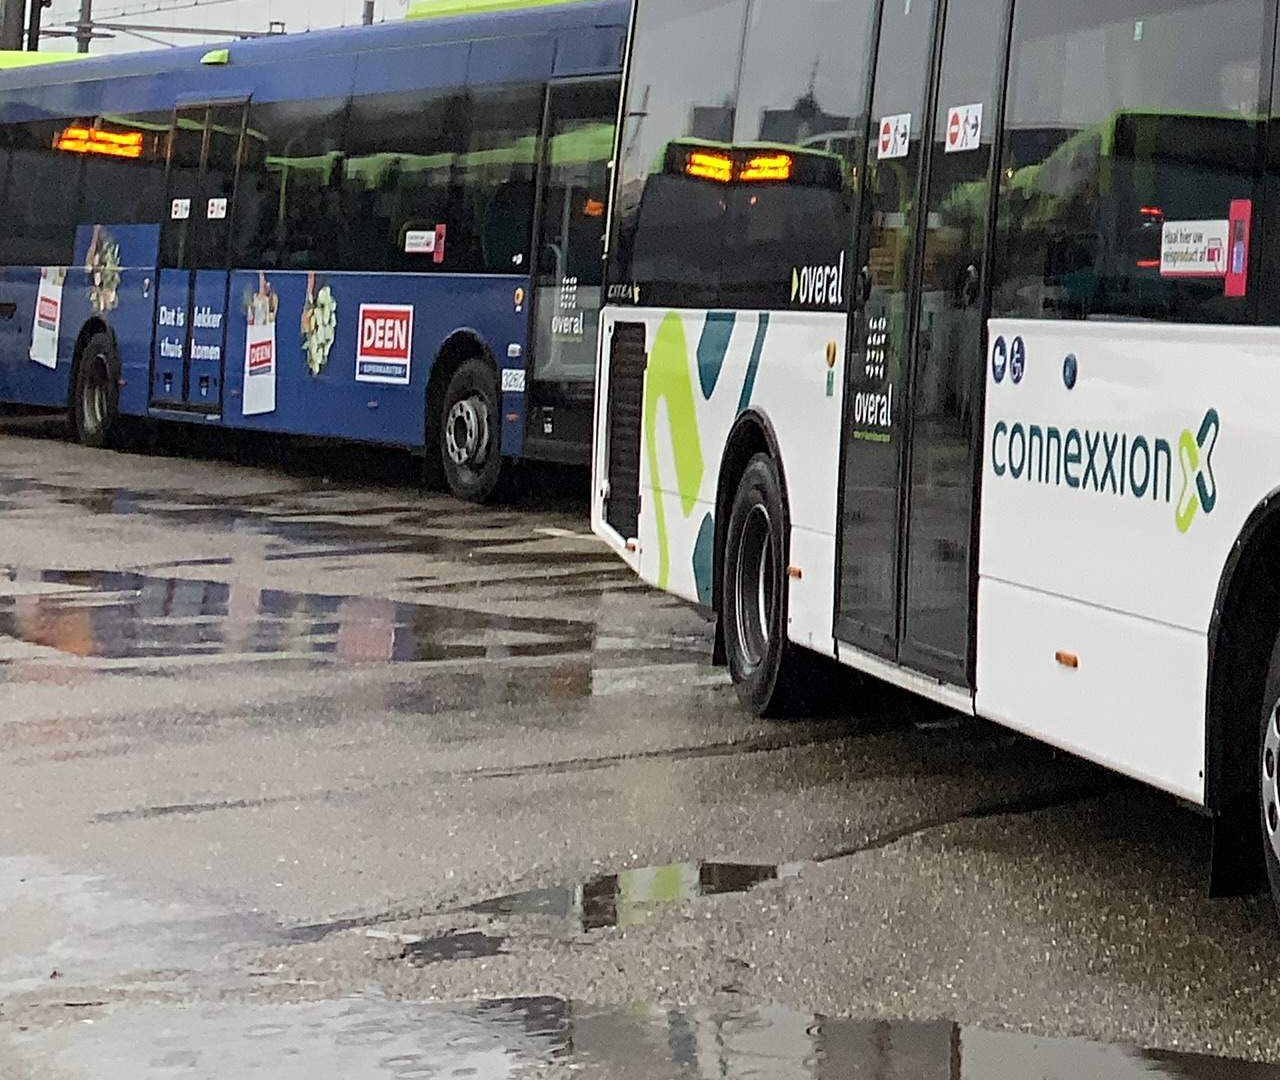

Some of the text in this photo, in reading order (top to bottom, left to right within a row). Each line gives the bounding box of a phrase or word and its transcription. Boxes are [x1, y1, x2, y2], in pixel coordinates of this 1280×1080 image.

[800, 249, 845, 304] overal
[160, 306, 222, 328] Dat is lekker
[551, 311, 584, 334] overal
[363, 318, 407, 350] DEEN
[161, 337, 220, 360] thuis komen
[250, 344, 272, 363] DEEN
[855, 383, 892, 427] overal
[992, 420, 1173, 503] connexxion
